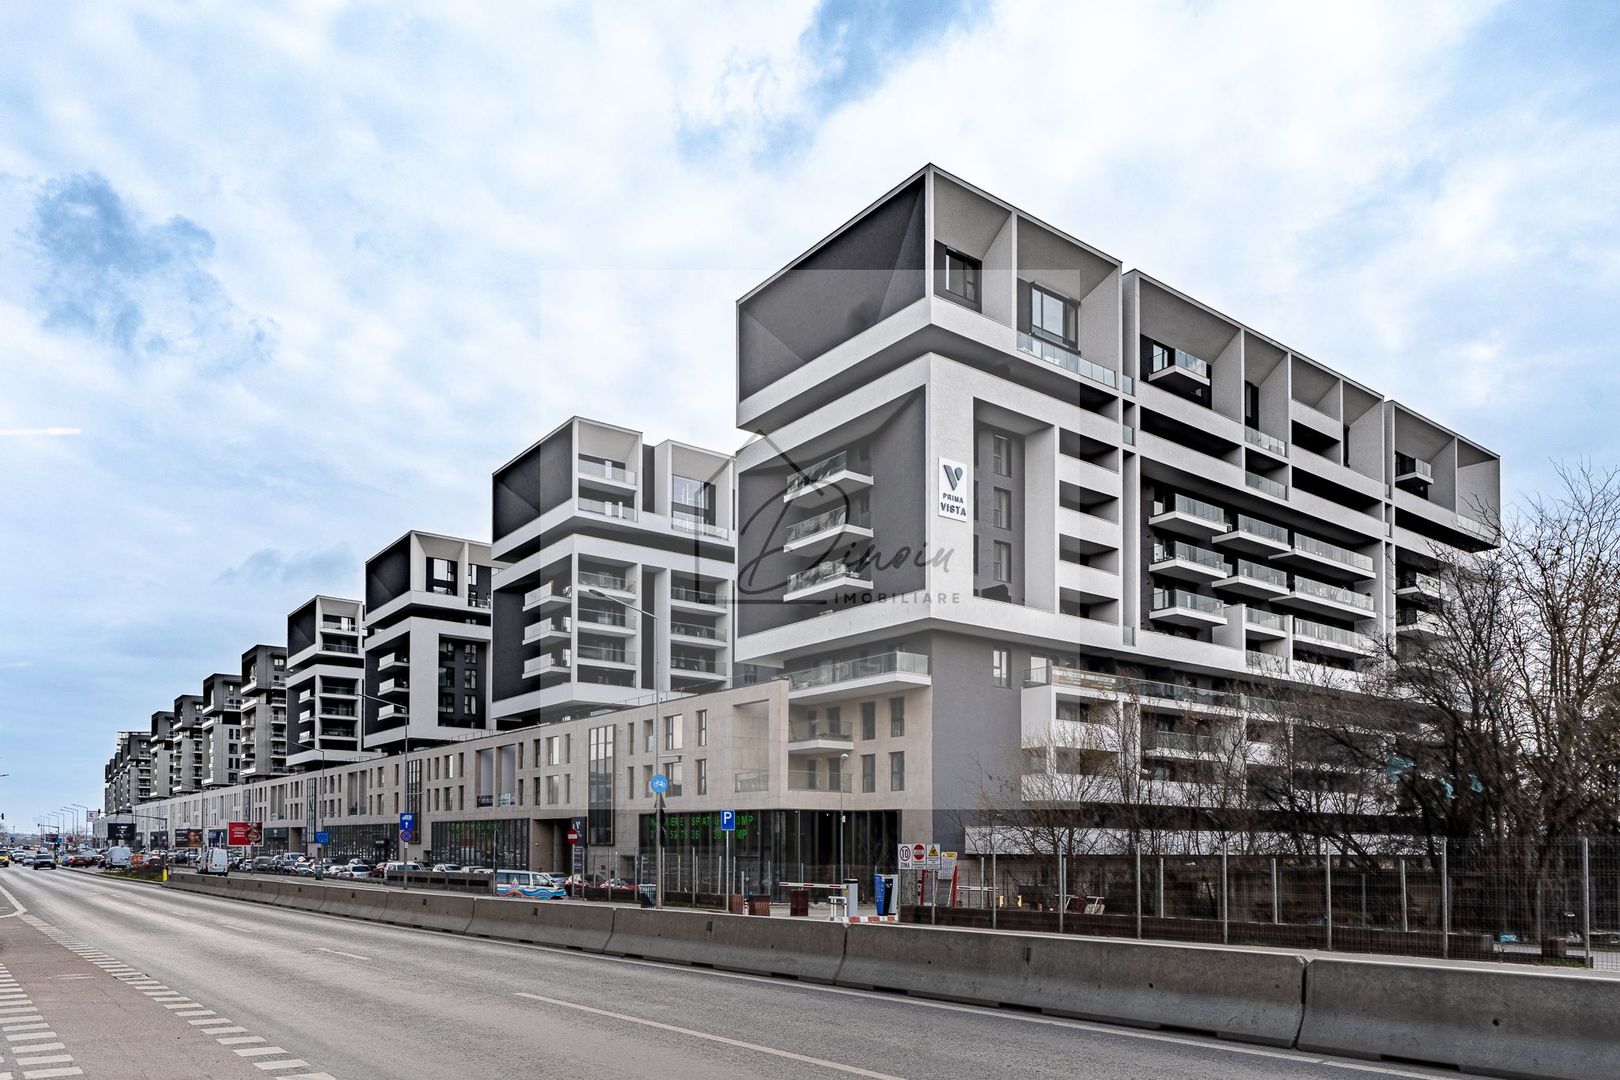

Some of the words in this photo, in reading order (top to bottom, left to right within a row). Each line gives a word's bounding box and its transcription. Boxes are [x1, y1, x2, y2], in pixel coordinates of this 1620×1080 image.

[942, 492, 964, 504] PRIMA
[940, 501, 967, 517] VISTA
[723, 811, 732, 825] P
[901, 849, 908, 858] 10
